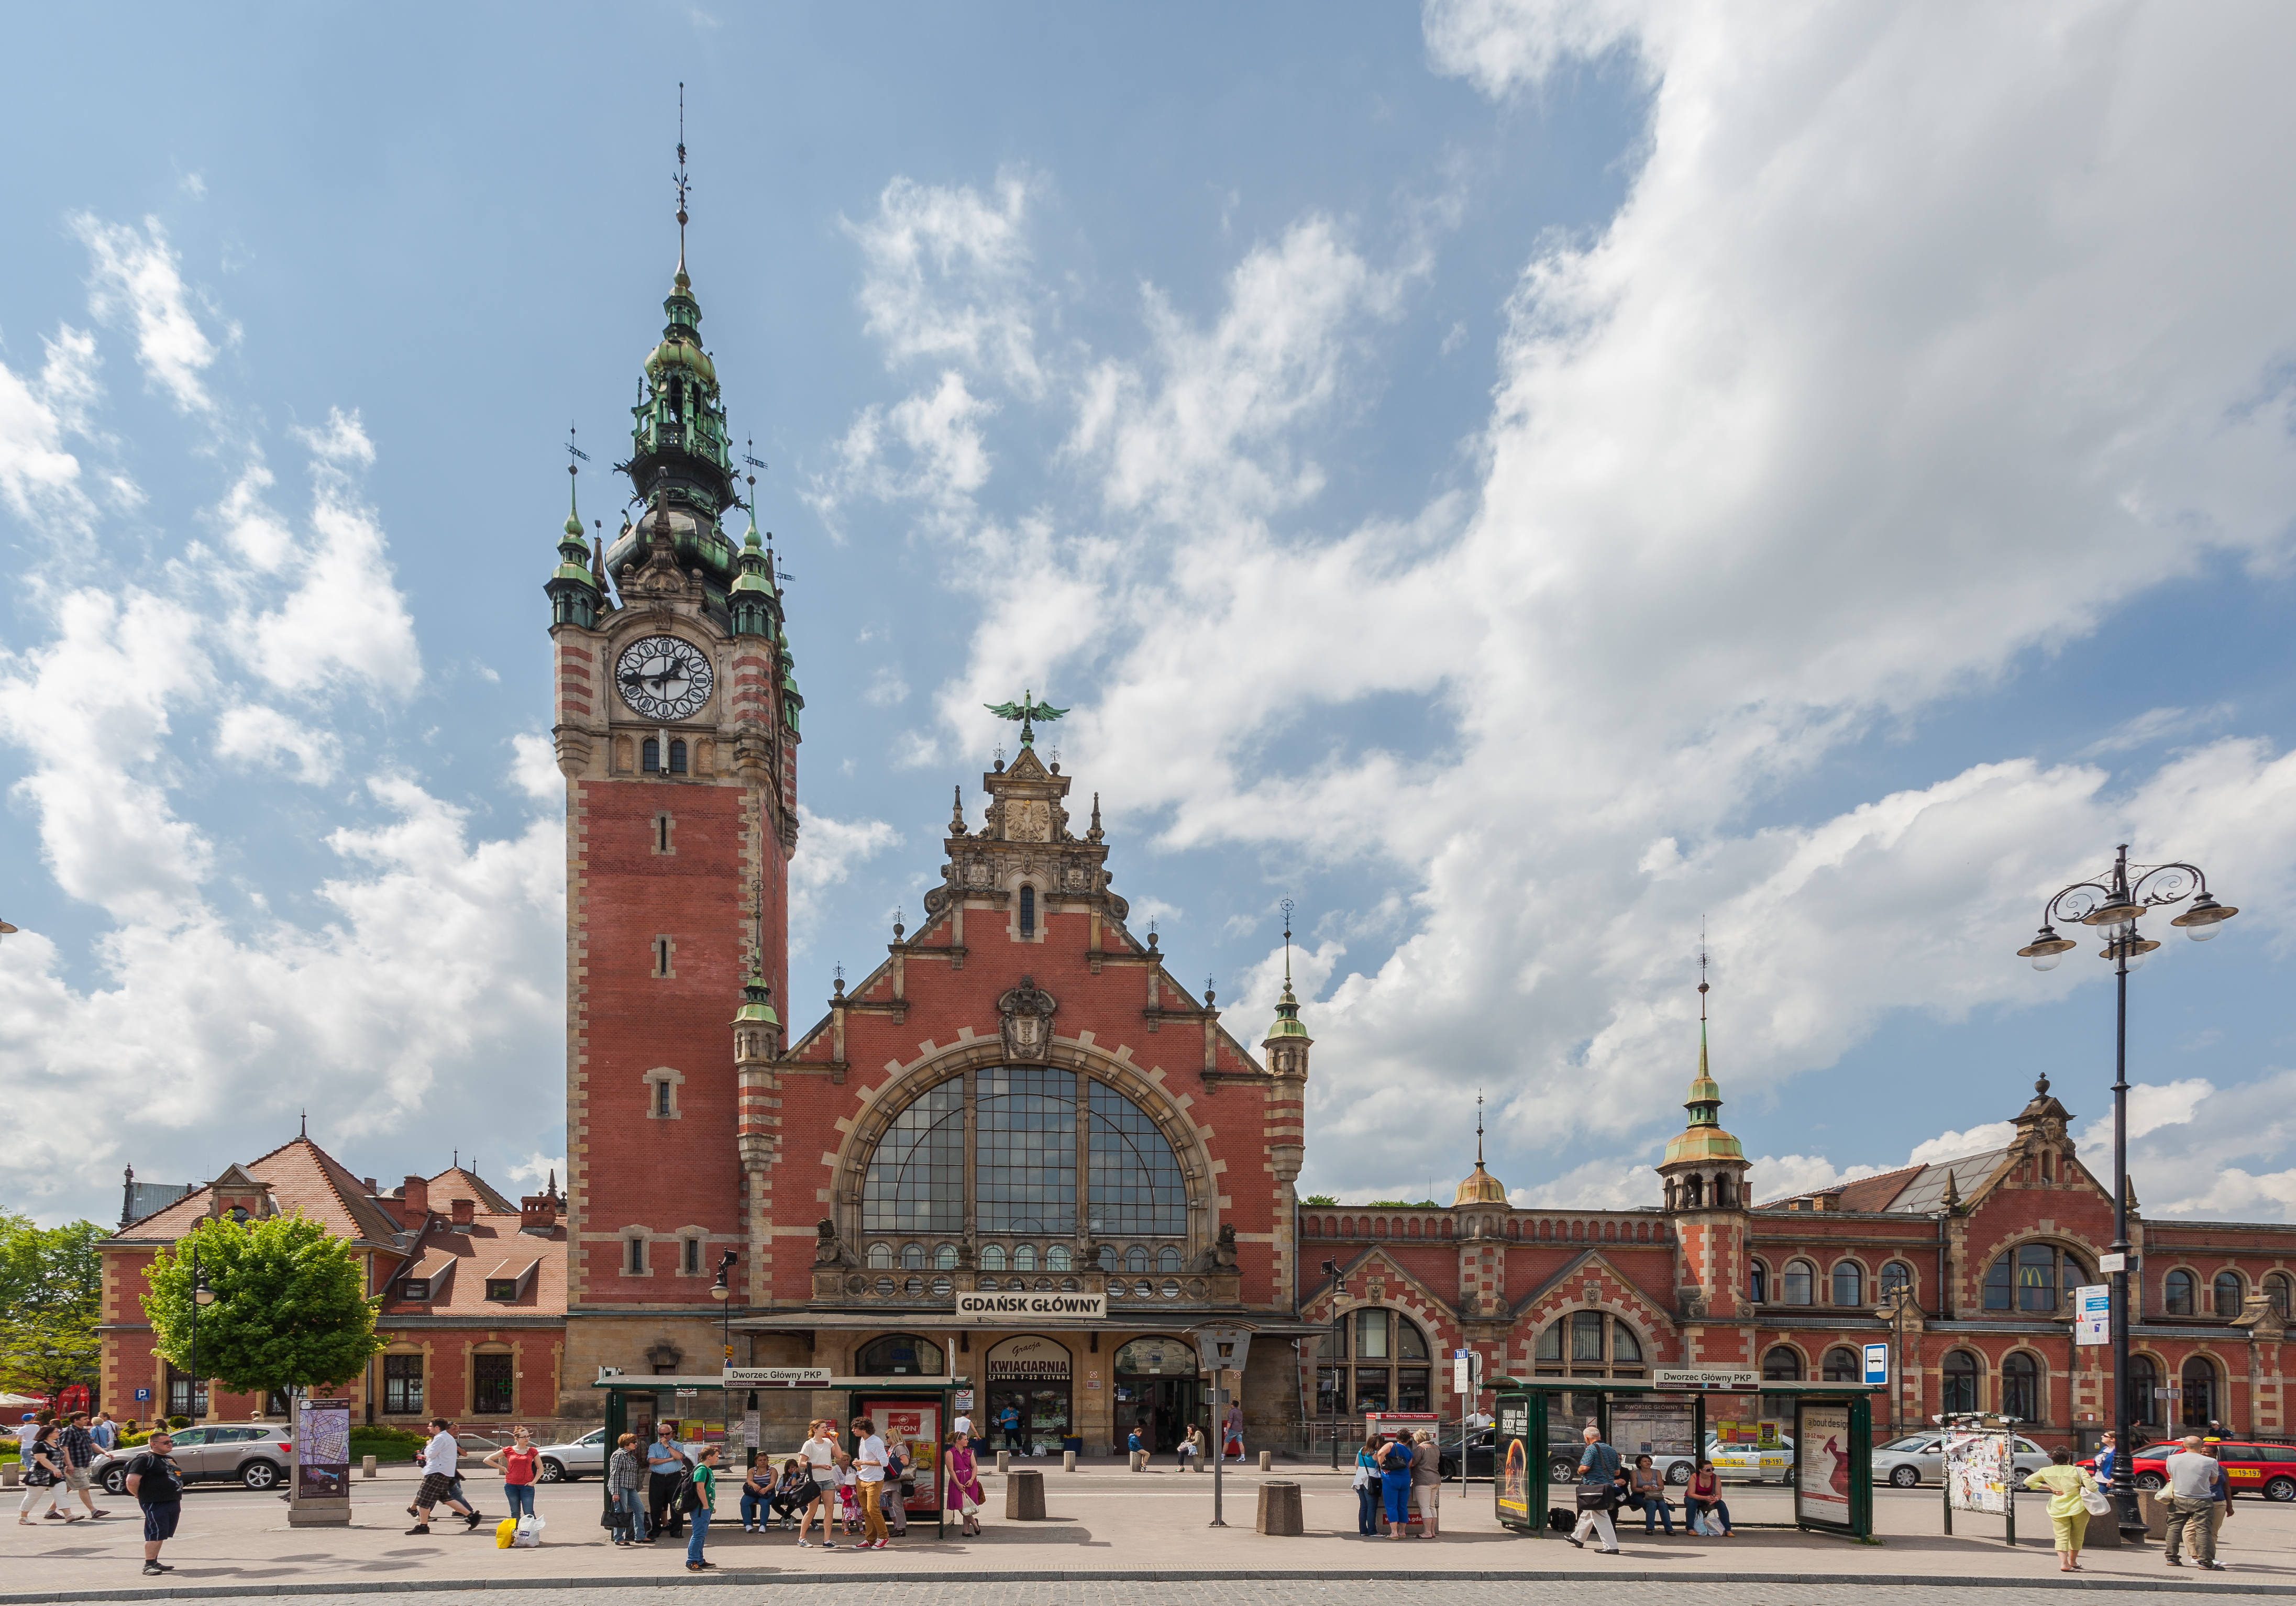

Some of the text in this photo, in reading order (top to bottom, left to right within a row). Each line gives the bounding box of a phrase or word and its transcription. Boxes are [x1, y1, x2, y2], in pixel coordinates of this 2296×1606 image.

[641, 645, 653, 656] XI
[660, 642, 670, 653] XII
[627, 656, 640, 665] X
[690, 661, 702, 669] II
[661, 704, 669, 715] VI
[680, 702, 689, 713] V
[961, 1295, 1101, 1312] GDAŃSK GŁÓWNY
[1012, 1342, 1042, 1357] Gracja
[1456, 1350, 1466, 1359] TAXI
[990, 1360, 1068, 1373] KWIACIARNIA
[770, 1370, 801, 1380] Główny
[1664, 1372, 1699, 1381] Dworzec
[1701, 1373, 1732, 1383] Główny
[138, 1389, 146, 1399] P
[1505, 1410, 1516, 1419] HUMAN
[1503, 1419, 1516, 1429] BODY
